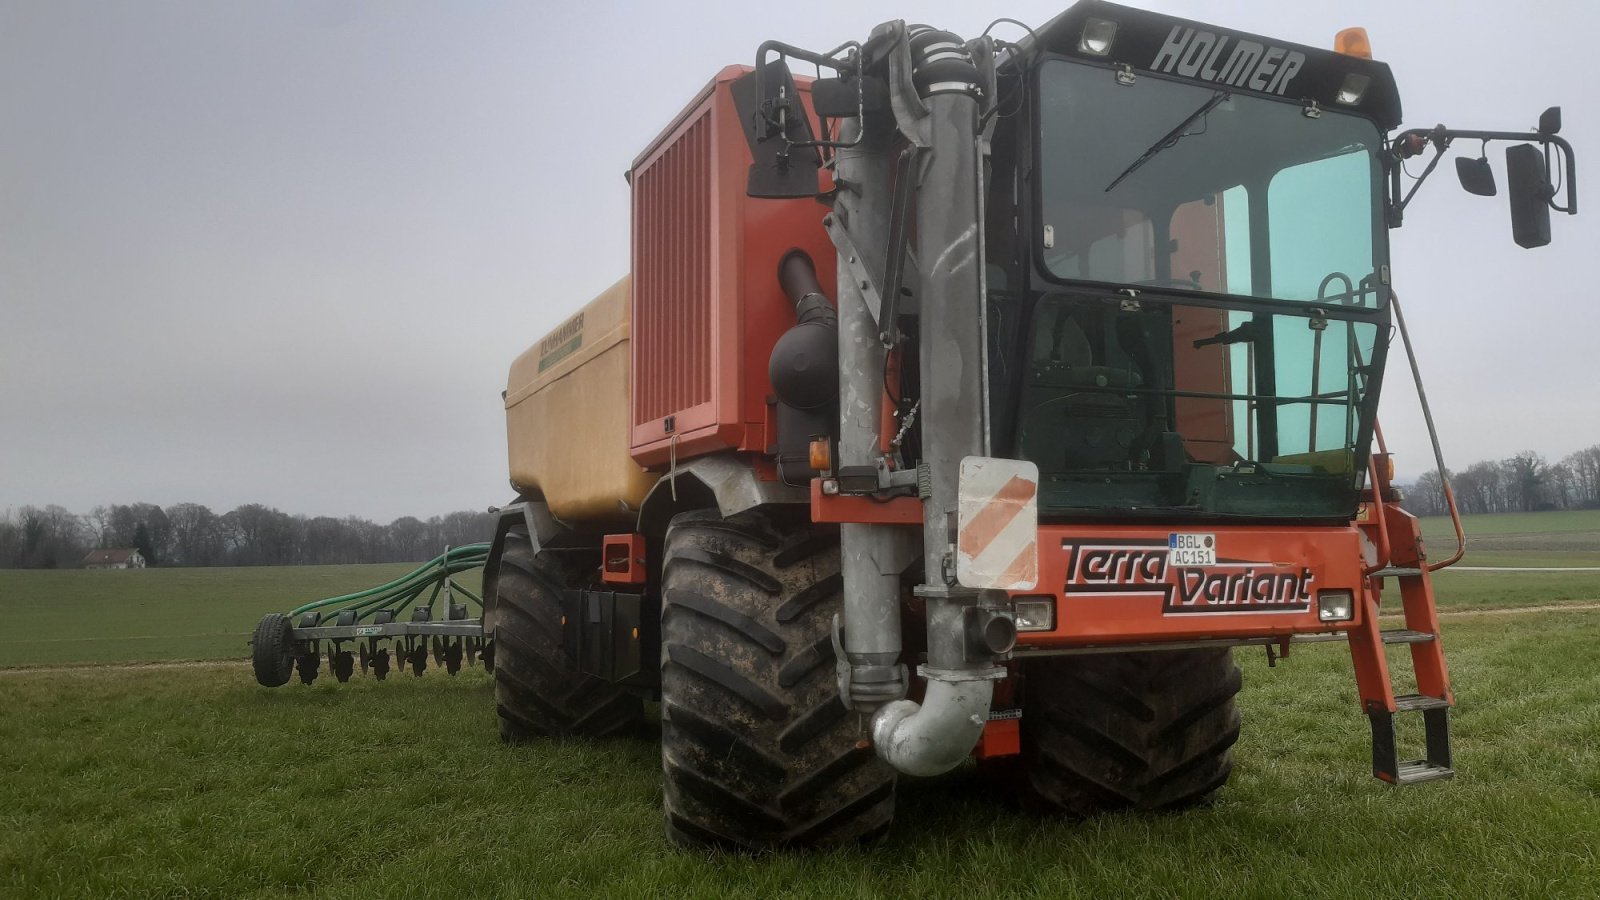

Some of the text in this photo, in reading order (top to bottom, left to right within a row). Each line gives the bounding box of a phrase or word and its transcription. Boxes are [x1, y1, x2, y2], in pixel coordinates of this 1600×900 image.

[1150, 25, 1306, 95] HOLMER
[1061, 537, 1169, 584] Terra
[1174, 550, 1212, 565] AC151
[1177, 535, 1201, 549] BGL
[1176, 566, 1314, 606] Variant
